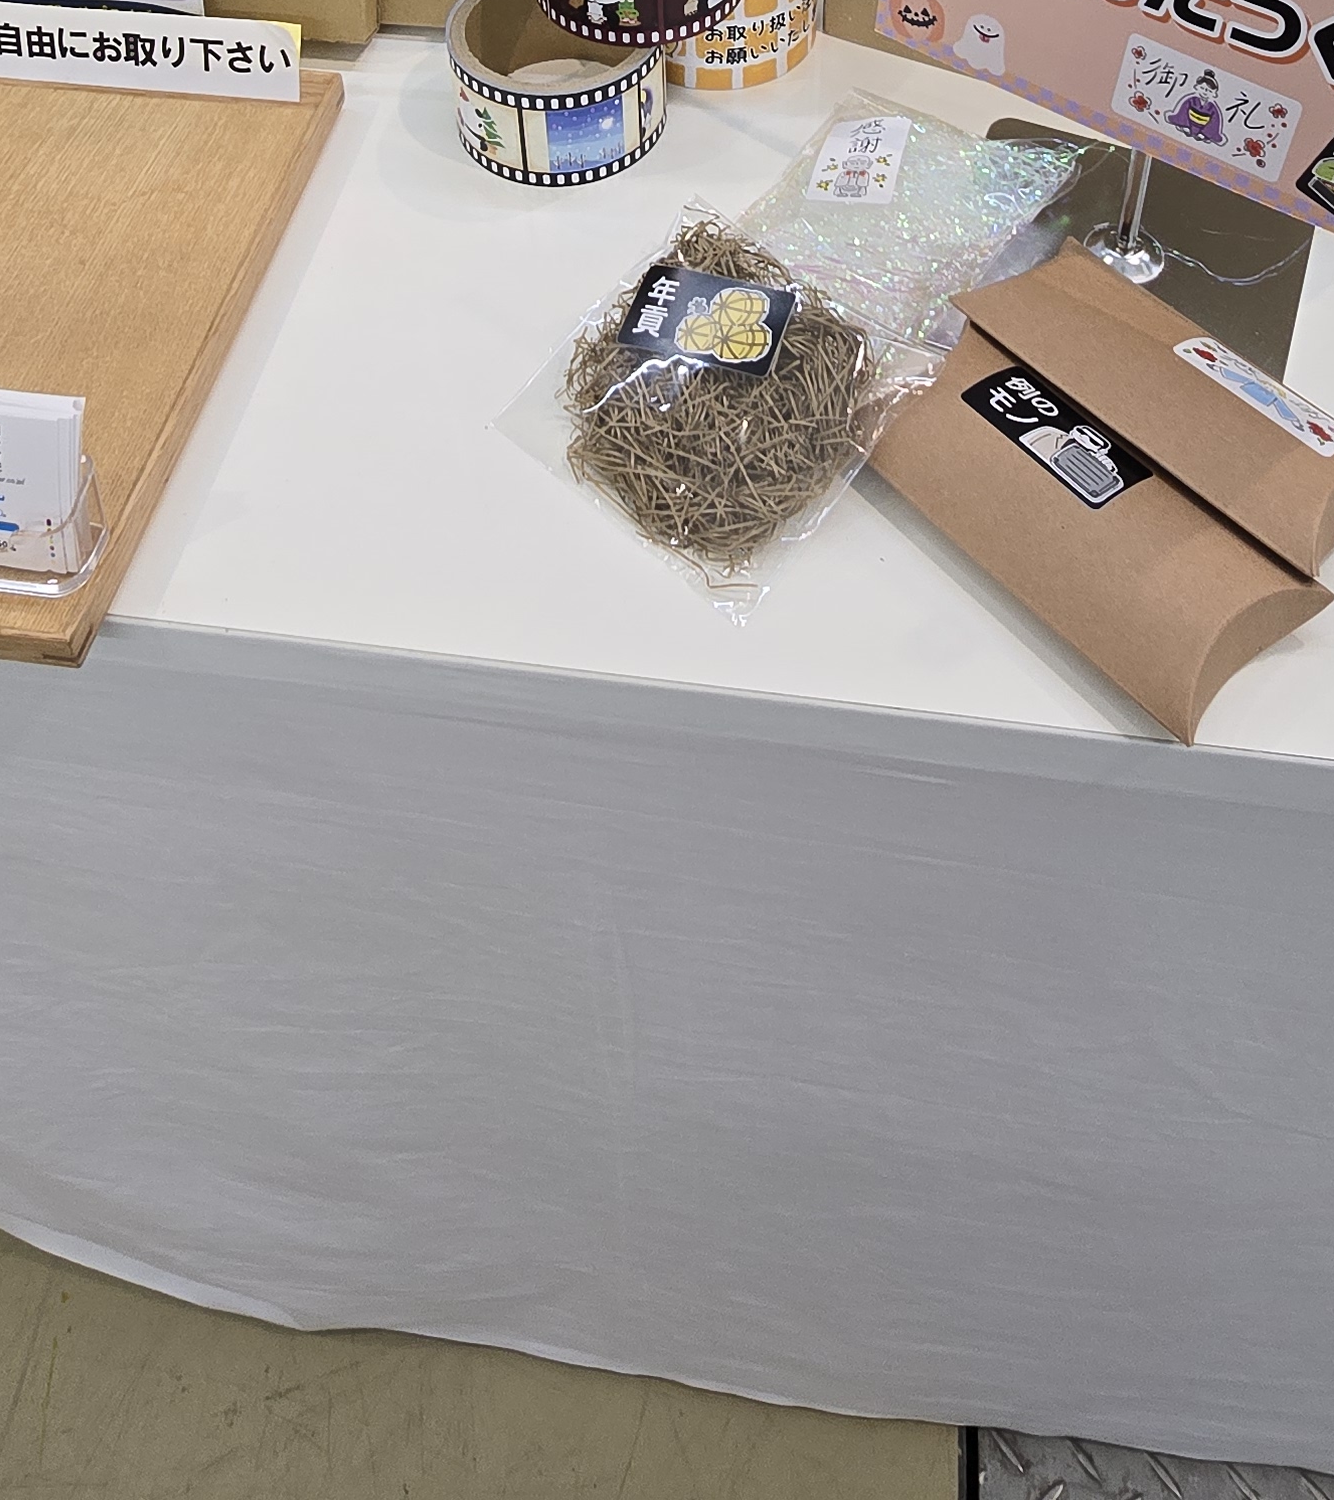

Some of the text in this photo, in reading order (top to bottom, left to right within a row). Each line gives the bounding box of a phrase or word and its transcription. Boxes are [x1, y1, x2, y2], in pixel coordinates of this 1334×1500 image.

[1142, 55, 1265, 131] 御 礼
[847, 117, 887, 155] 感謝
[631, 276, 681, 338] 年貢
[988, 387, 1040, 424] モノ
[1002, 376, 1059, 418] 例の
